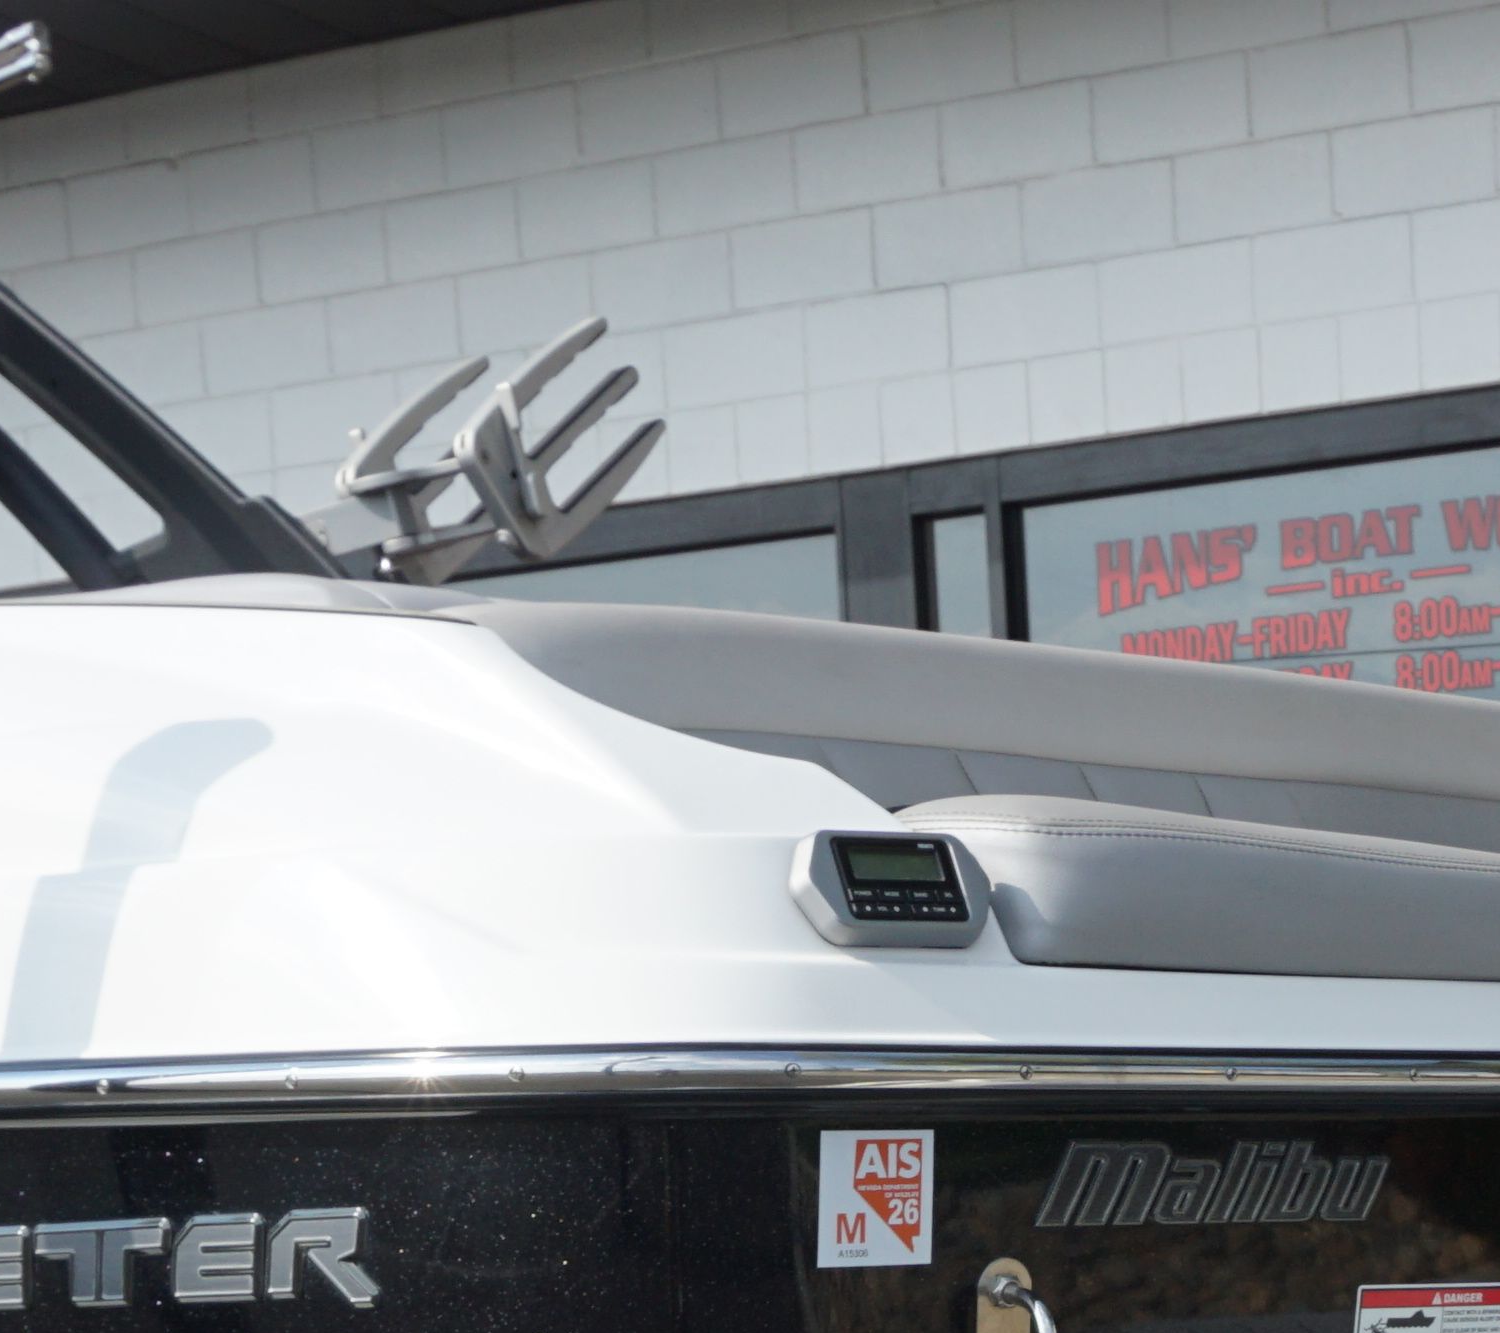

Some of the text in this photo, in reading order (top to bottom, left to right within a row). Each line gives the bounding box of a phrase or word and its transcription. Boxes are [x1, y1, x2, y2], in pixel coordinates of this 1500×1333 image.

[1094, 523, 1258, 618] HANS'
[1279, 504, 1422, 571] BOAT
[1331, 568, 1404, 598] inc.
[855, 1142, 921, 1179] AIS
[1035, 1139, 1392, 1227] Malibu
[836, 1212, 866, 1244] M
[887, 1199, 920, 1225] 26
[1443, 1292, 1483, 1303] DANGER
